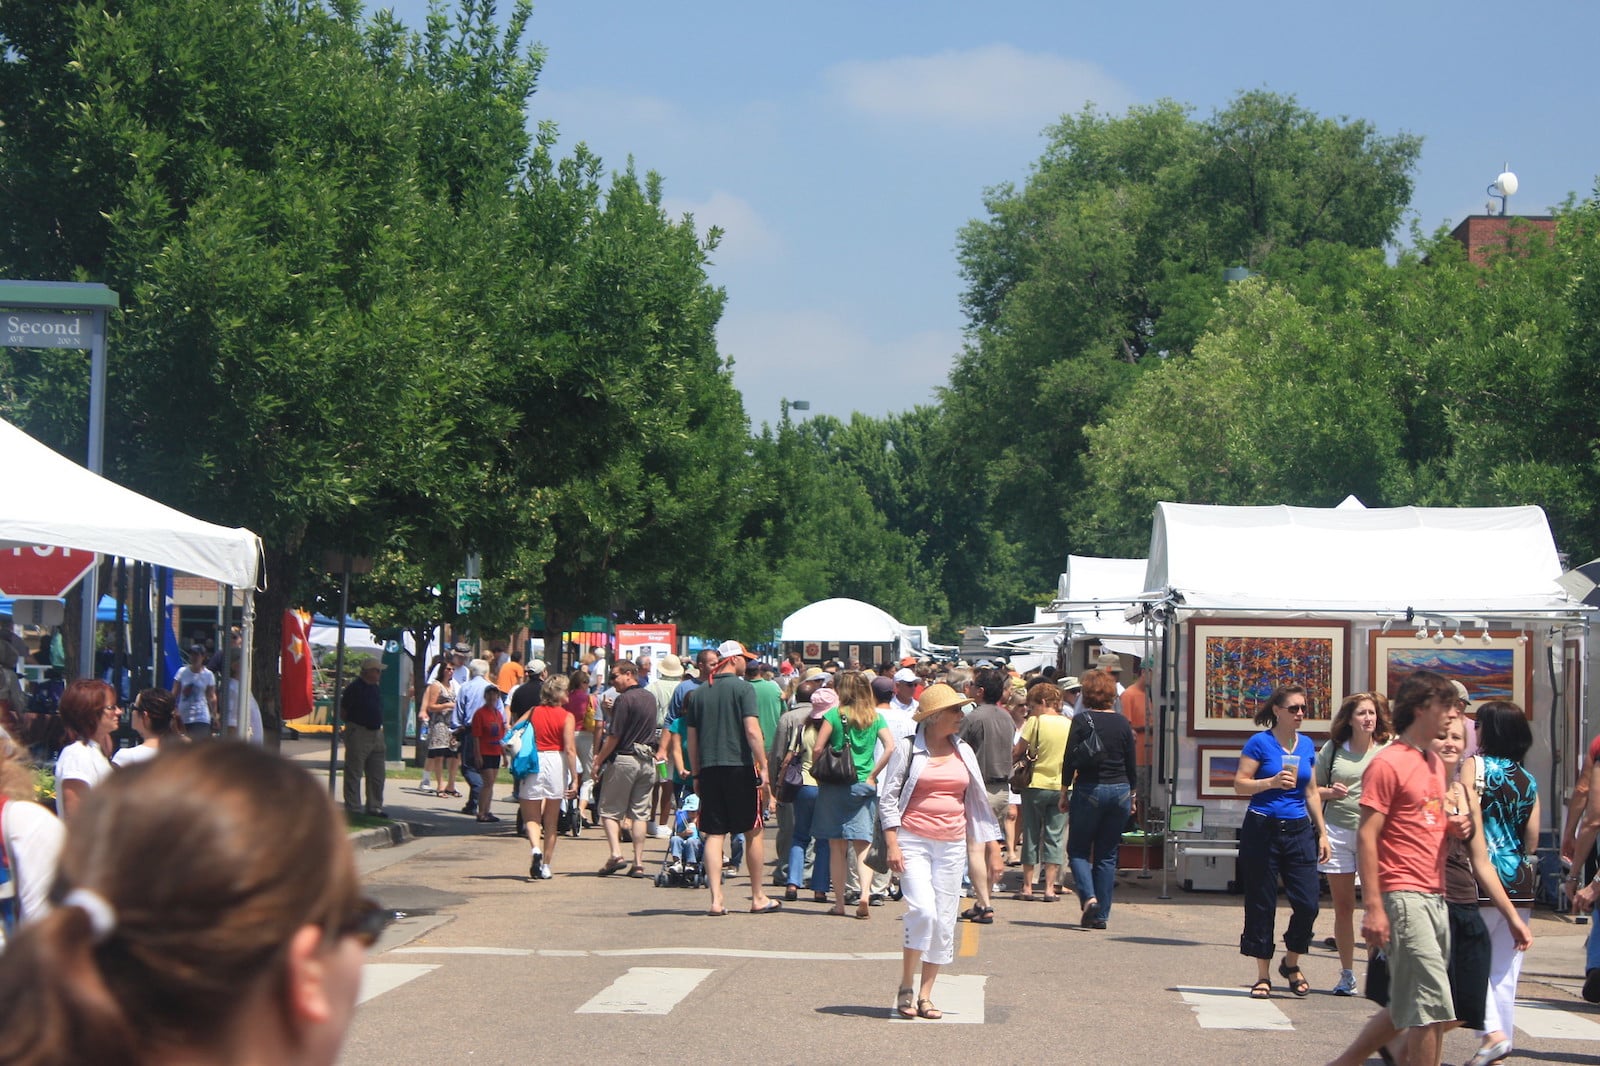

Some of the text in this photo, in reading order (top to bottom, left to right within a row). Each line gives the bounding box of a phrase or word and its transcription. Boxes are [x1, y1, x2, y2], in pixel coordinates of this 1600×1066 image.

[8, 316, 80, 335] Second
[8, 335, 25, 344] AVE
[73, 337, 81, 345] N
